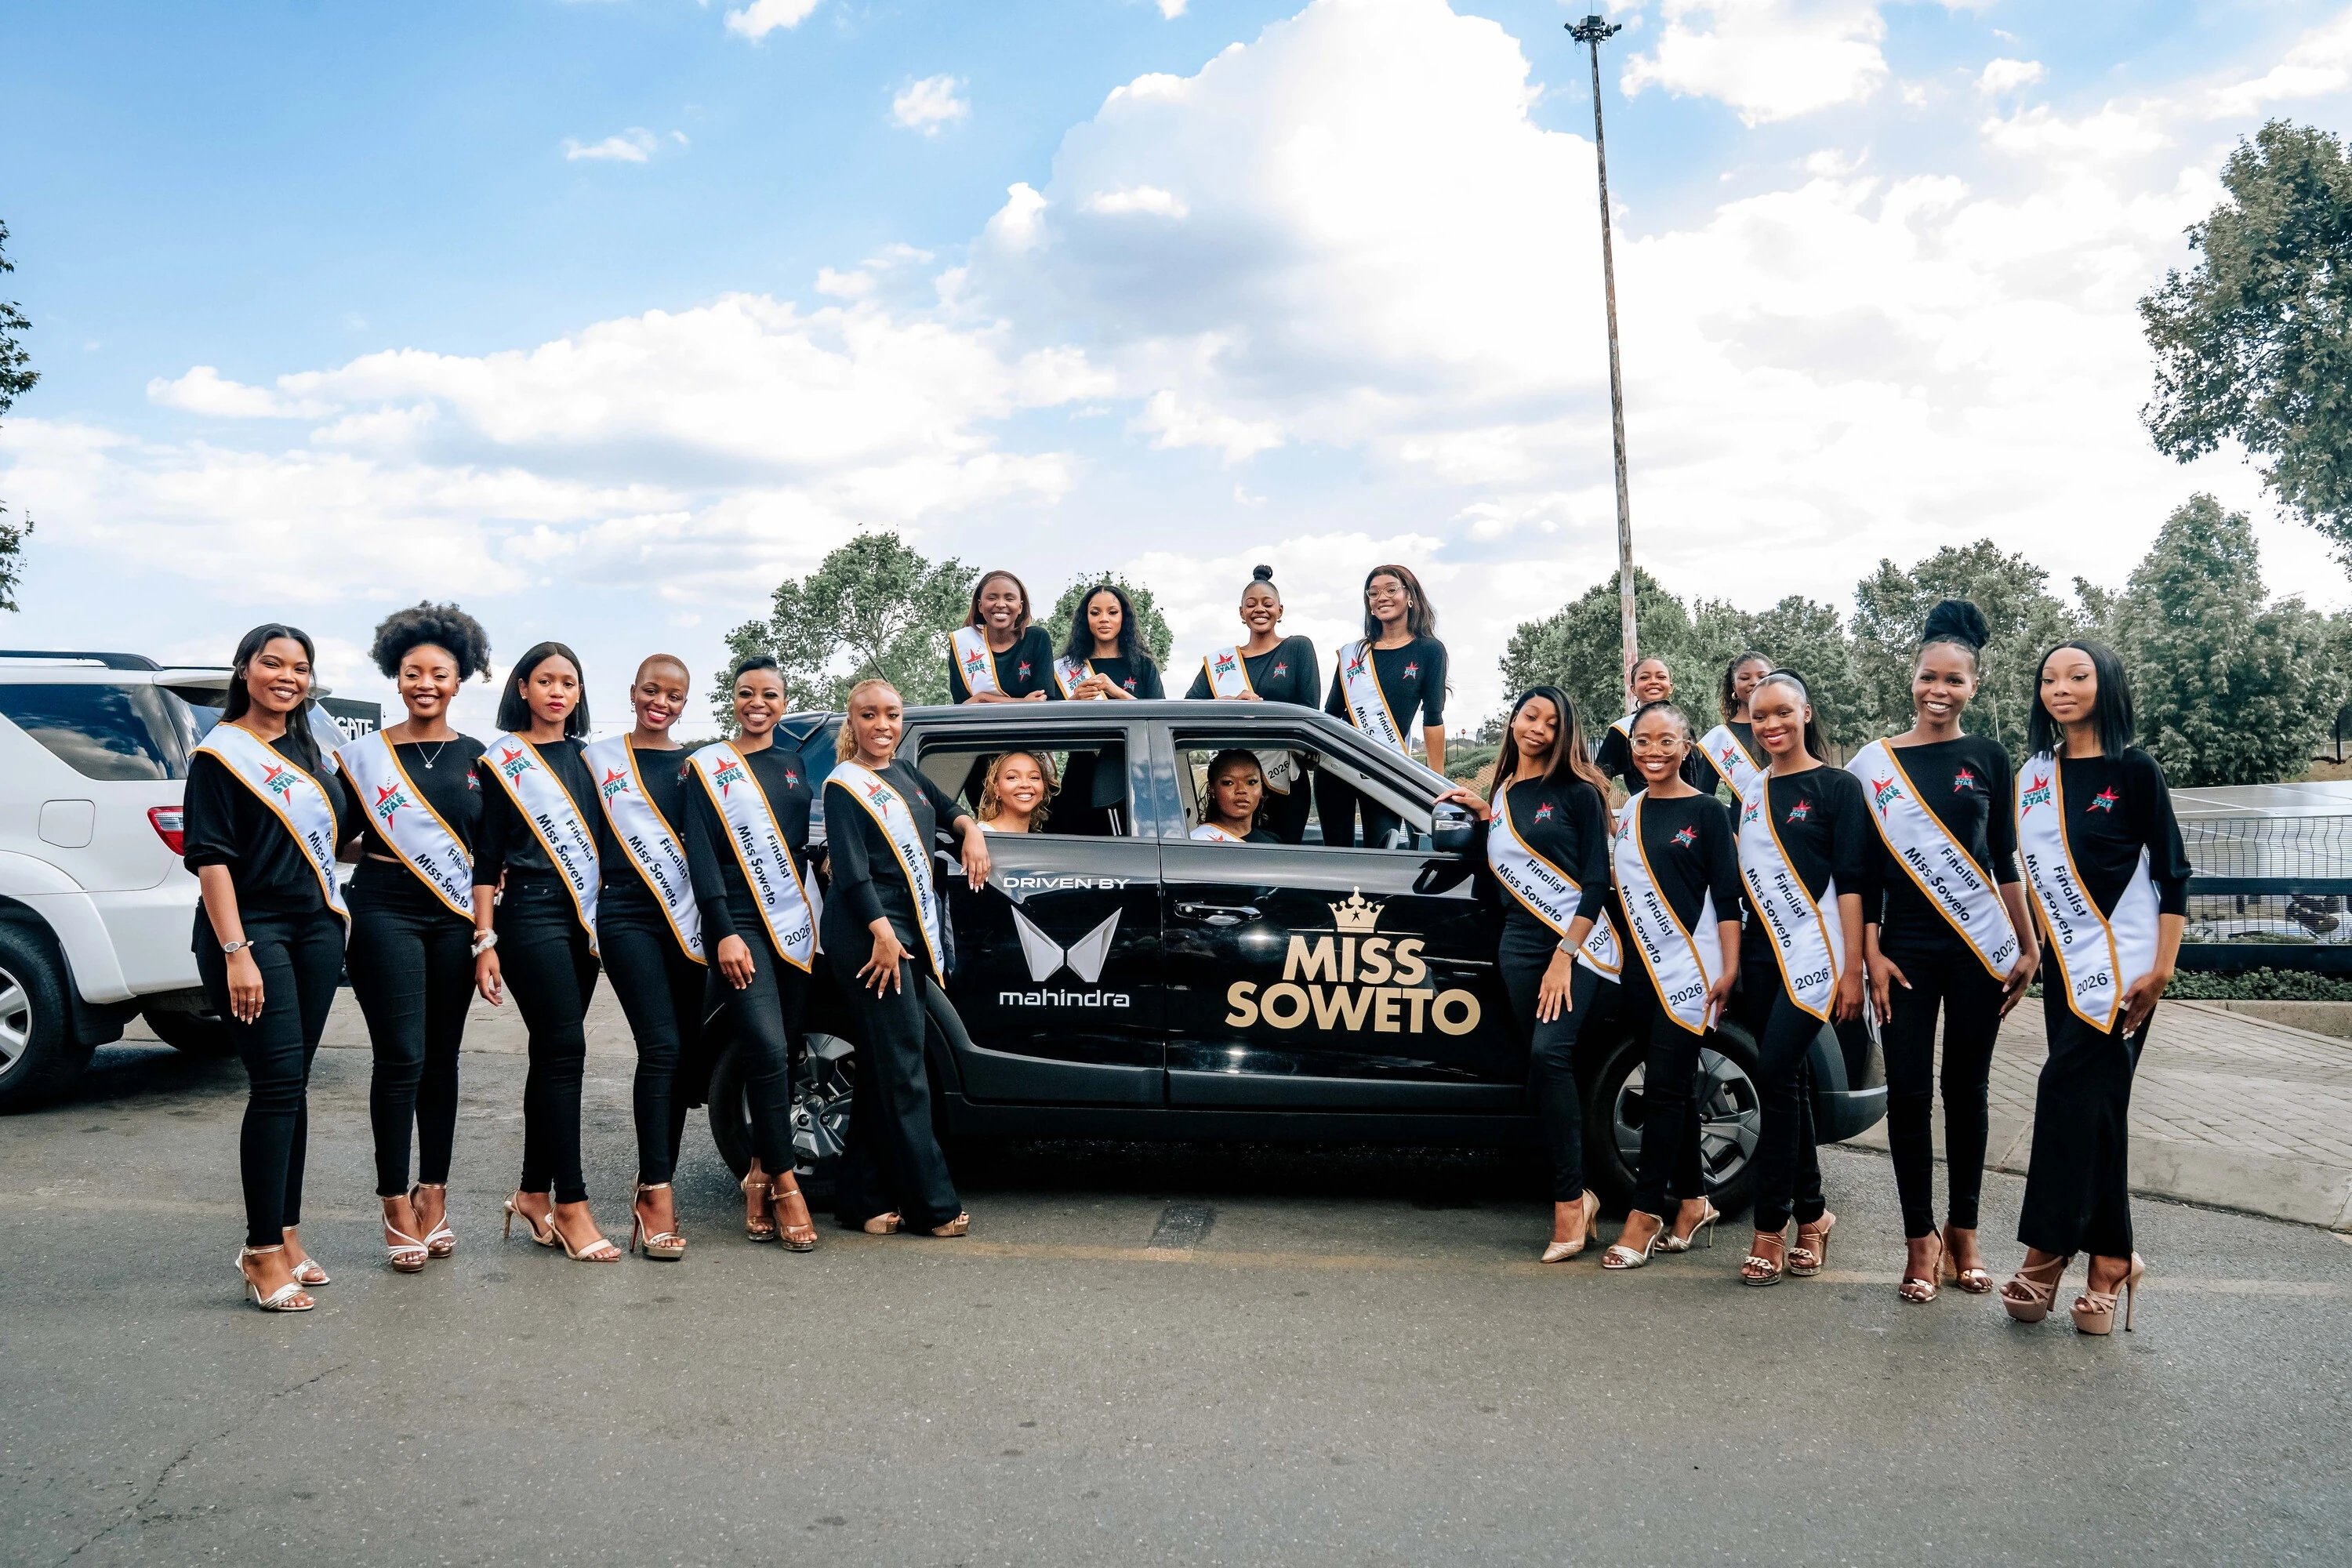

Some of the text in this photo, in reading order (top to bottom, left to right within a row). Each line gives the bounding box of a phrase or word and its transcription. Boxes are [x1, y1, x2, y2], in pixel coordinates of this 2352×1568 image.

[967, 659, 983, 668] WHITE
[967, 663, 985, 674] STAR
[1215, 664, 1236, 674] STAR
[332, 716, 373, 739] GATE
[1356, 706, 1369, 728] Miss
[1377, 711, 1396, 743] Finalist
[503, 756, 526, 771] WHITE
[506, 759, 533, 779] STAR
[1268, 760, 1290, 779] 2026
[1722, 753, 1736, 765] WHITE
[1725, 756, 1740, 771] STAR
[268, 771, 290, 786] WHITE
[273, 775, 299, 794] STAR
[603, 778, 625, 791] WHITE
[715, 767, 739, 780] WHITE
[717, 771, 745, 788] STAR
[377, 791, 401, 811] WHITE
[604, 782, 628, 800] STAR
[869, 787, 887, 802] WHITE
[873, 792, 893, 808] STAR
[1878, 789, 1901, 811] STAR
[2022, 792, 2050, 808] STAR
[2024, 786, 2049, 799] WHITE
[379, 796, 408, 819] STAR
[2092, 800, 2113, 808] STAR
[308, 831, 325, 861] Miss
[566, 819, 593, 862] Finalist
[1675, 833, 1691, 844] STAR
[536, 814, 584, 891] Miss Soweto
[659, 838, 688, 880] Finalist
[767, 834, 791, 879] Finalist
[902, 843, 919, 873] Miss
[415, 854, 442, 880] Miss
[629, 835, 677, 907] Miss Soweto
[738, 825, 775, 906] Miss Soweto
[1526, 858, 1566, 894] Finalist
[1940, 848, 1980, 891] Finalist
[1003, 877, 1131, 890] DRIVEN BY
[1497, 863, 1563, 923] Miss Soweto
[1904, 847, 1969, 922] Miss Soweto
[2053, 866, 2088, 917] Finalist
[1774, 873, 1806, 919] Finalist
[2027, 854, 2073, 945] Miss Soweto
[1644, 891, 1675, 937] Finalist
[1746, 868, 1791, 949] Miss Soweto
[785, 924, 811, 946] 2026
[1621, 885, 1661, 964] Miss Soweto
[1588, 926, 1611, 952] 2026
[1992, 935, 2016, 964] 2026
[1282, 935, 1426, 985] MISS
[1795, 967, 1829, 990] 2026
[2078, 972, 2108, 996] 2026
[999, 989, 1130, 1008] mahindra
[1670, 983, 1703, 1006] 2026
[1225, 981, 1481, 1036] SOWETO
